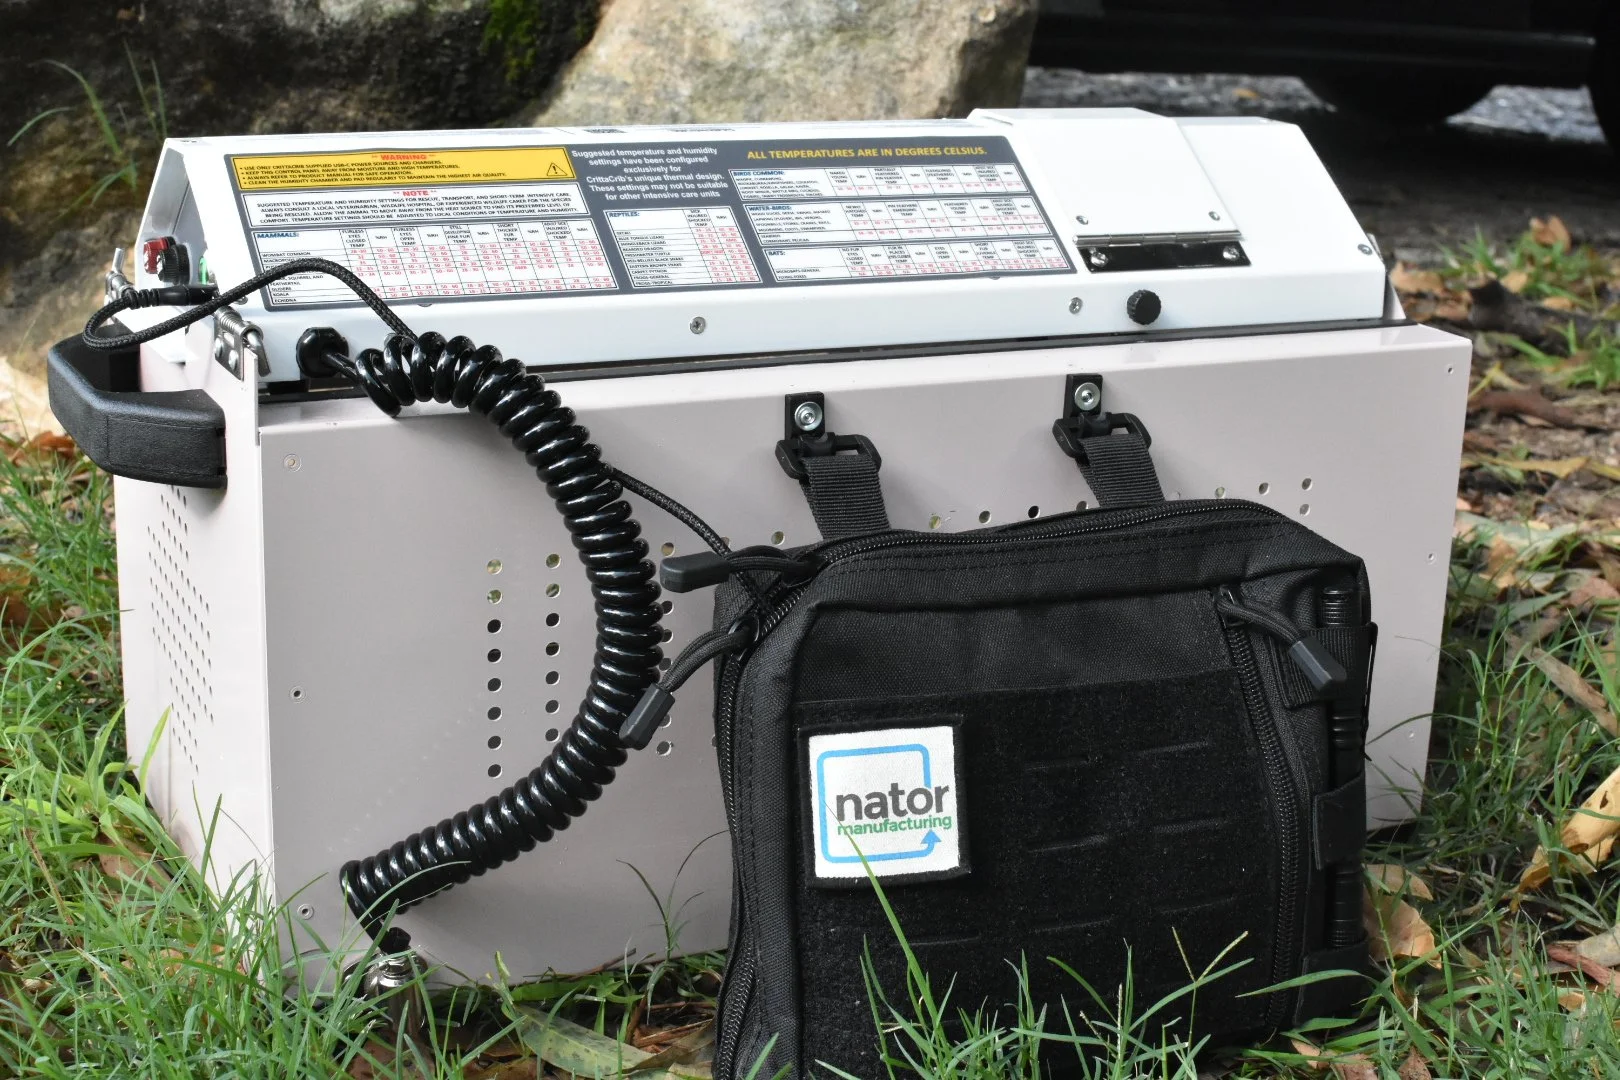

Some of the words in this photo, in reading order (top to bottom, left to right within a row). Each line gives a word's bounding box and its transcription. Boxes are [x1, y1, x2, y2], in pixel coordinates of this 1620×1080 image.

[571, 150, 616, 158] Suggested
[616, 149, 665, 157] temperature
[747, 150, 768, 159] ALL
[768, 149, 856, 158] TEMPERATURES
[855, 149, 879, 157] ARE
[879, 148, 893, 157] IN
[893, 148, 942, 156] DEGREES
[942, 147, 987, 156] CELSIUS.
[666, 156, 708, 164] configured
[624, 165, 668, 173] exclusively
[836, 783, 949, 821] nator
[837, 815, 952, 835] manufacturing
